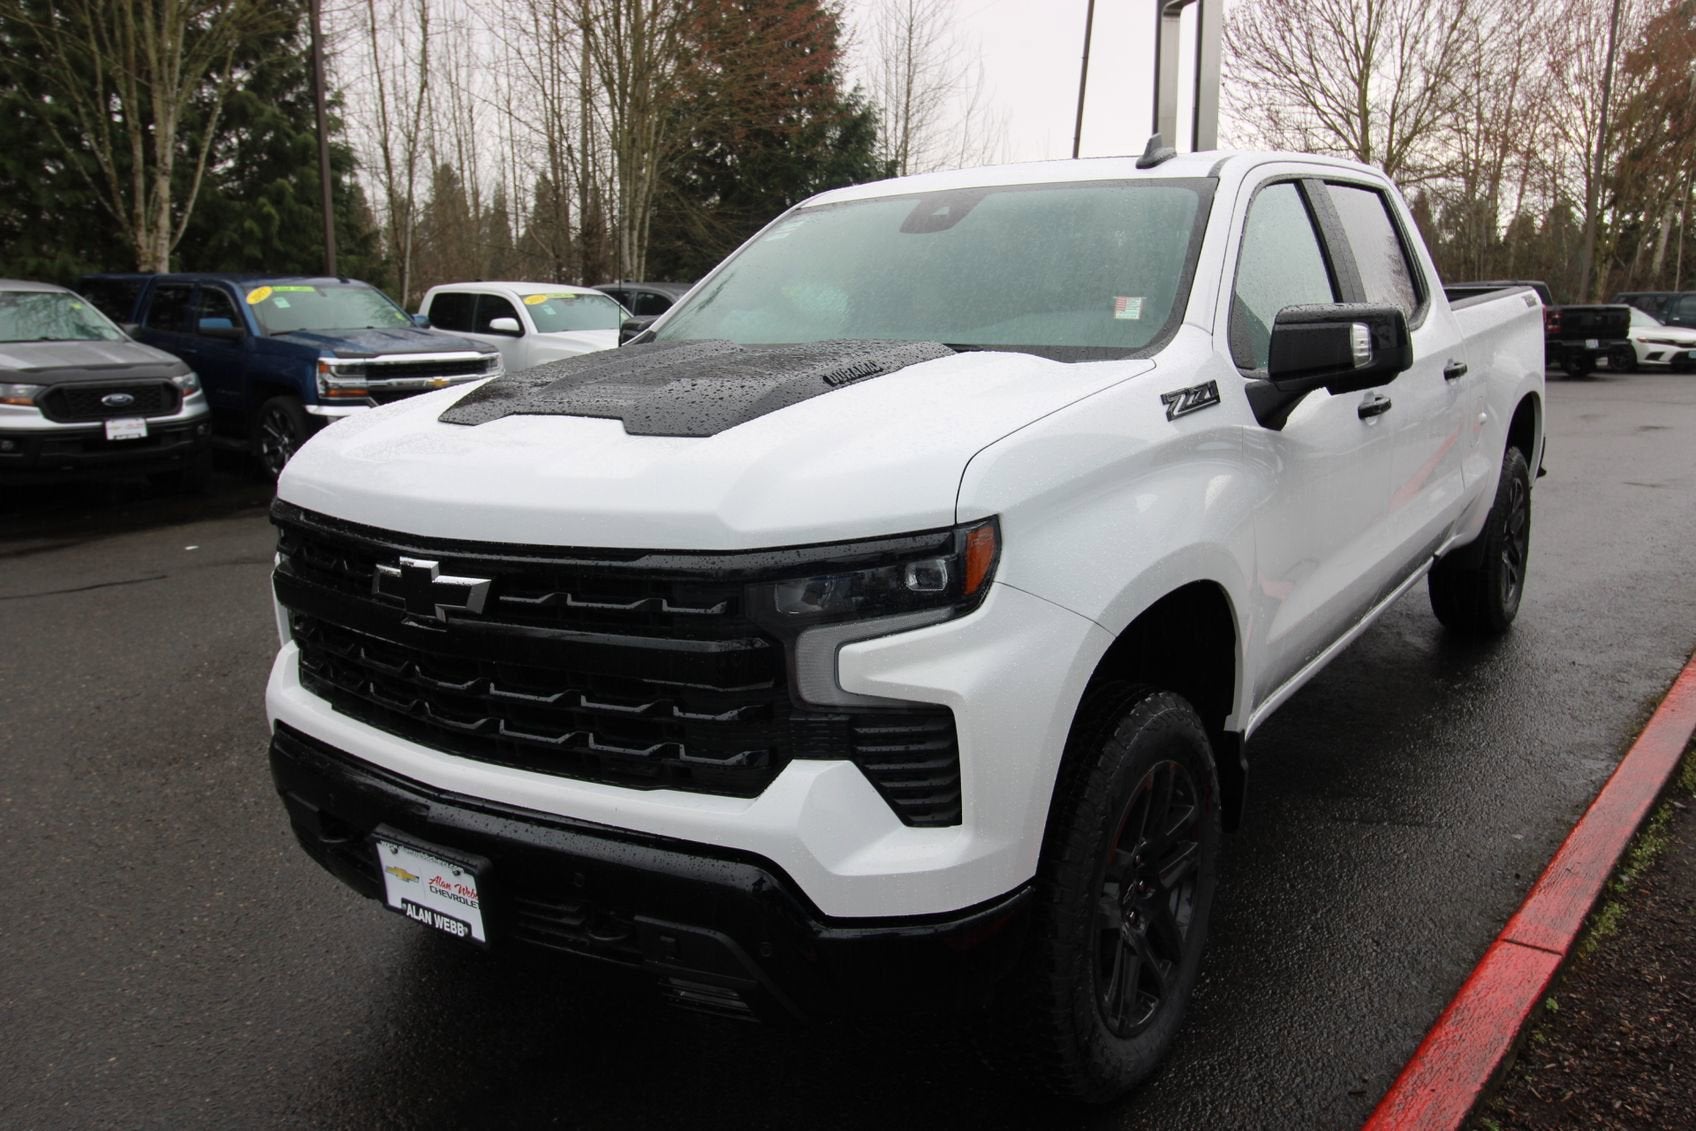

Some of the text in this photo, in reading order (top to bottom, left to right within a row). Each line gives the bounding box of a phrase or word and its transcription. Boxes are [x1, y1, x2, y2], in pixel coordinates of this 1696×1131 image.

[428, 875, 479, 900] Alan Web
[406, 903, 465, 937] ALAN WEBB
